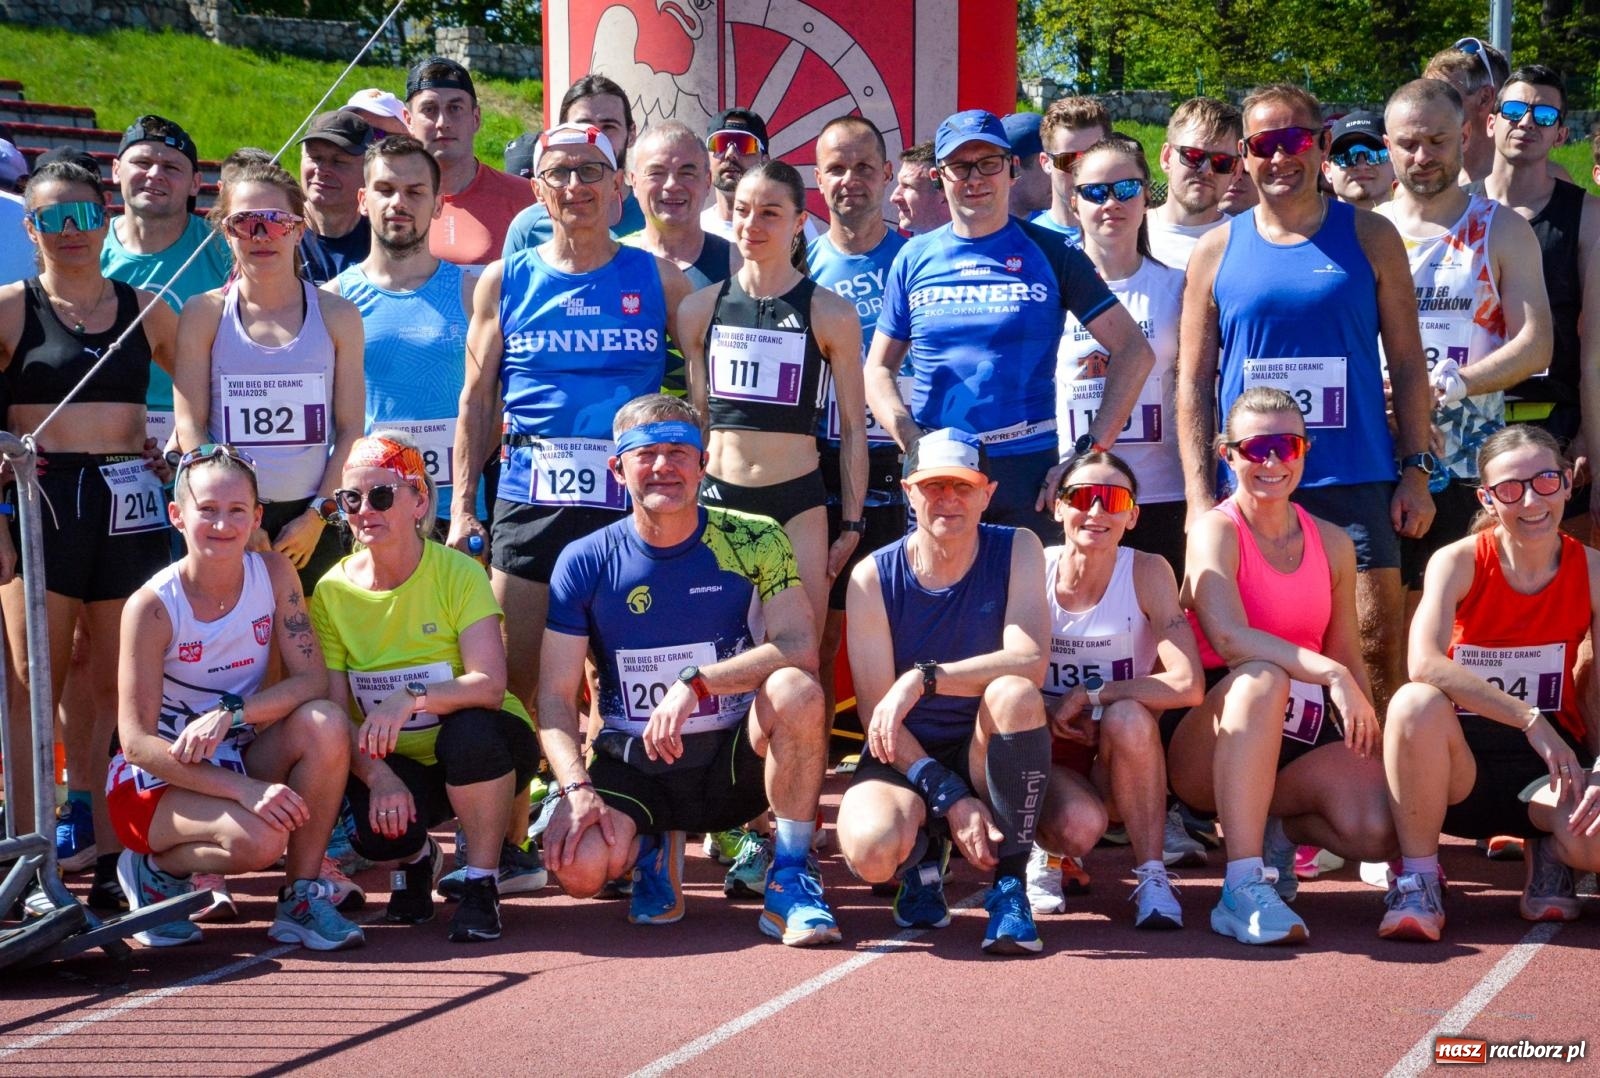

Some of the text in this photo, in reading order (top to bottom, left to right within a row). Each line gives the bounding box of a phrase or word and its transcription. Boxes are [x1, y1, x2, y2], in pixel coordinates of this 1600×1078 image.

[1345, 120, 1371, 128] KIPRUN
[909, 283, 1048, 310] RUNNERS
[988, 305, 1020, 313] TEAM
[506, 328, 659, 353] RUNNERS
[746, 334, 757, 342] BEZ
[758, 335, 783, 344] GRANIC
[1074, 333, 1092, 341] BIE
[1251, 363, 1324, 372] XVIII BIEG BEZ GRANIC
[730, 360, 760, 388] 111
[1251, 371, 1288, 380] 3MAJA2026
[228, 380, 244, 388] XVIII
[264, 380, 276, 388] BEZ
[278, 379, 303, 388] GRANIC
[1073, 384, 1087, 392] XVIII
[229, 389, 267, 397] 3MAJA2026
[240, 407, 294, 435] 182
[411, 425, 422, 433] BEZ
[424, 424, 446, 433] GRANIC
[984, 426, 1037, 442] IMPRESPORT
[583, 444, 607, 452] GRANIC
[548, 469, 595, 494] 129
[125, 491, 158, 520] 214
[1055, 639, 1070, 647] BIEG
[1072, 640, 1084, 648] BEZ
[1086, 639, 1111, 648] GRANIC
[1050, 646, 1076, 654] JA2026
[1481, 650, 1497, 658] BIEG
[1514, 650, 1541, 658] GRANIC
[623, 651, 693, 664] XVIII BIEG BEZ GRANIC
[1461, 658, 1503, 667] 3MAJA2026
[624, 664, 658, 672] 3MAJA2026
[355, 671, 430, 684] XVIII BIEG BEZ GRANIC
[1050, 662, 1101, 688] 135
[632, 682, 668, 709] 20
[1017, 770, 1046, 843] Kalenji
